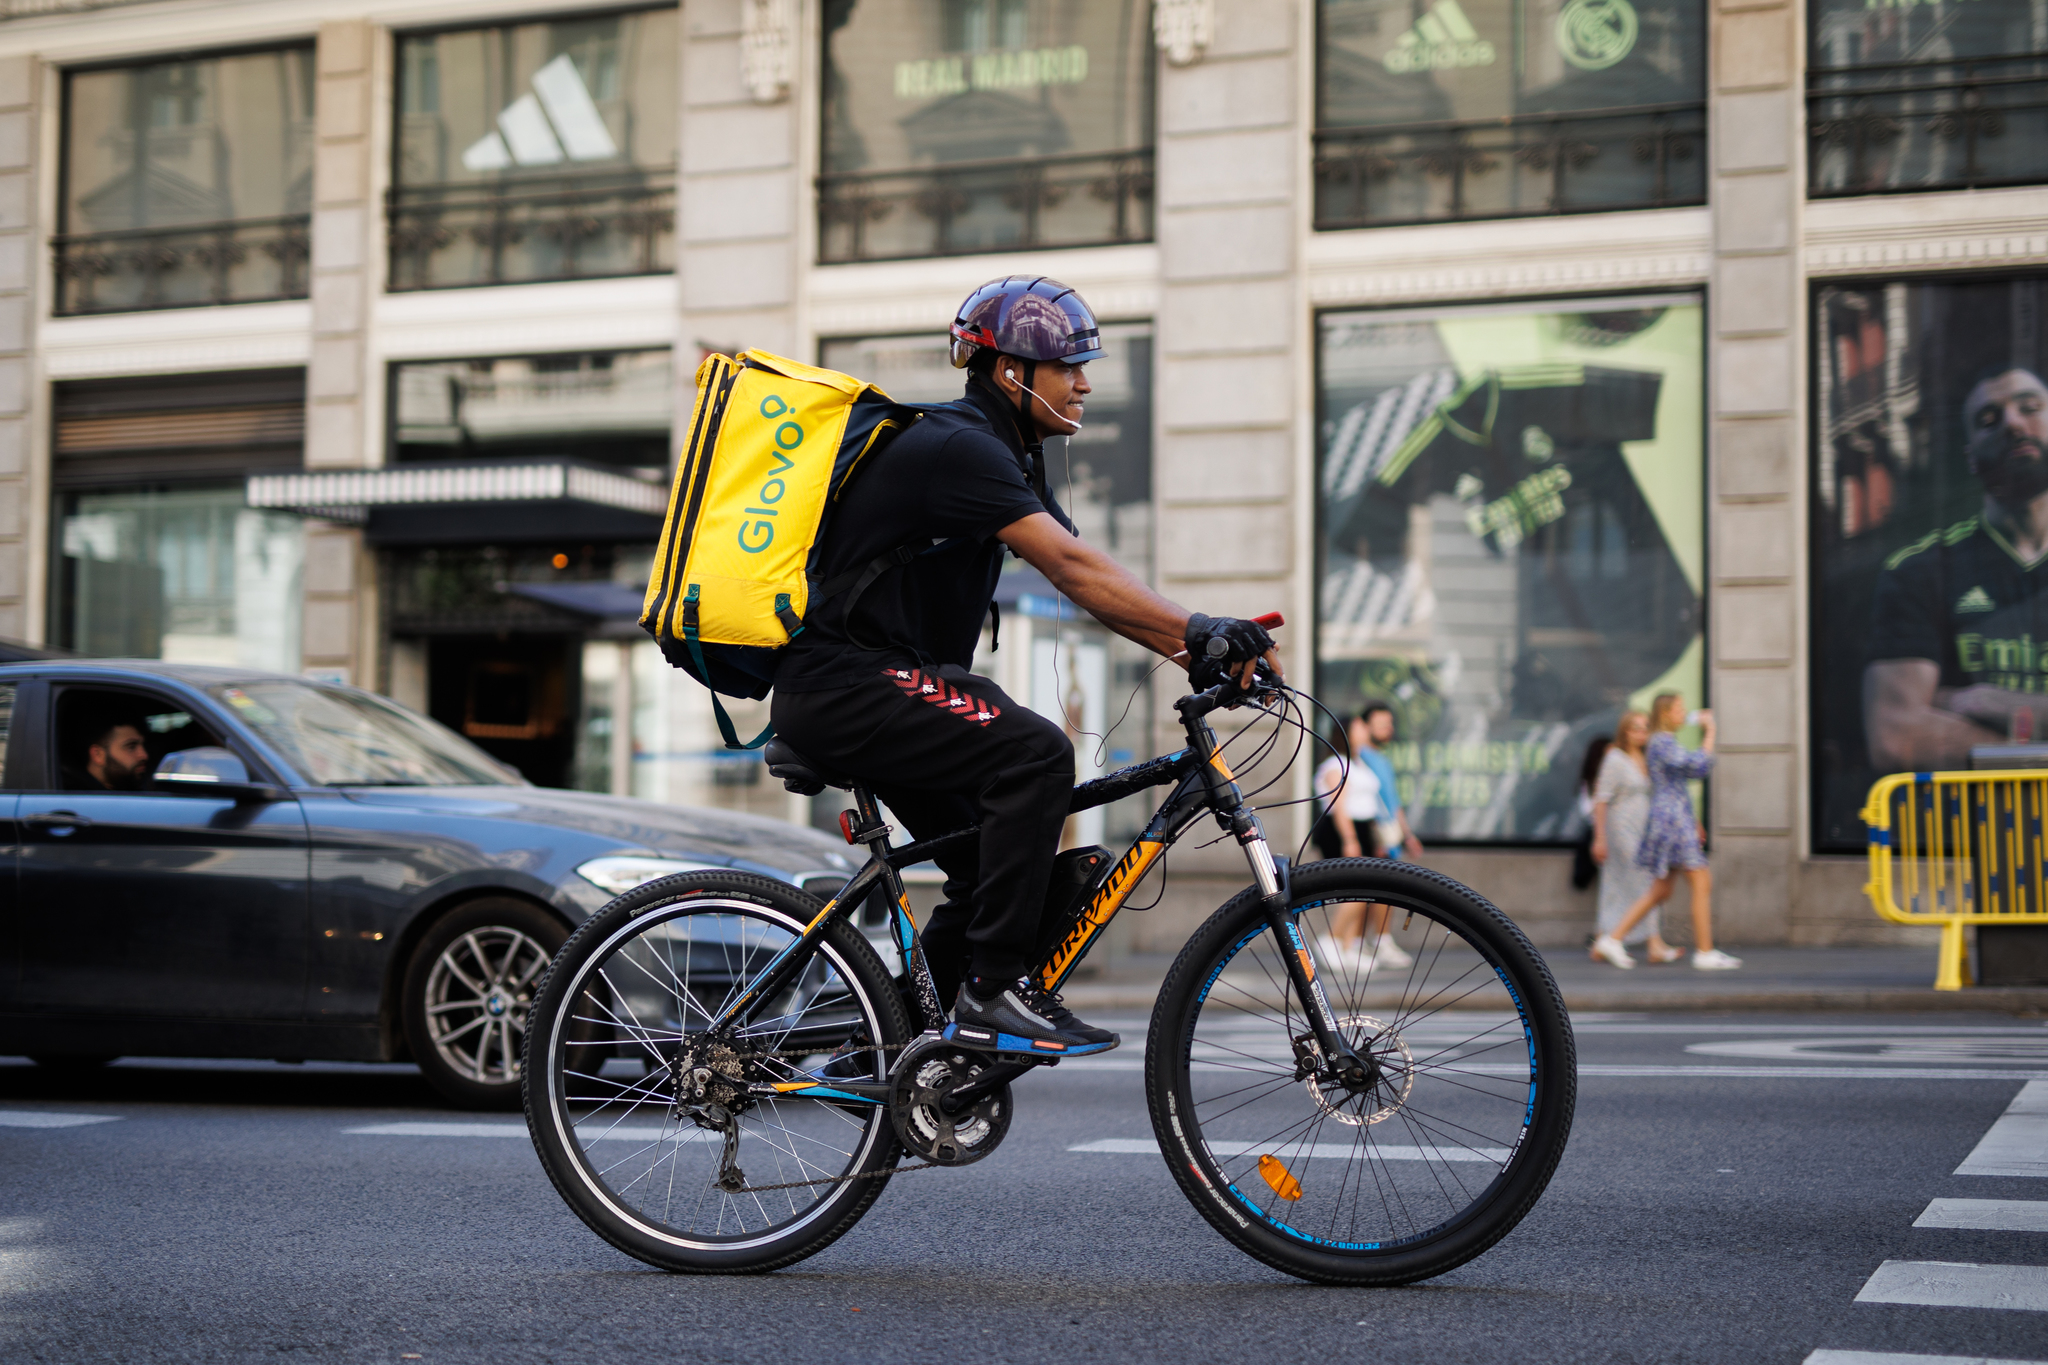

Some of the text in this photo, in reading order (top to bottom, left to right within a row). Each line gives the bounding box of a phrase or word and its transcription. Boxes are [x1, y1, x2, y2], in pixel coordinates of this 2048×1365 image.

[893, 45, 1088, 98] REAL MADRID
[1383, 40, 1496, 75] adidas
[738, 421, 804, 553] Glovo
[629, 895, 676, 918] Panaracer
[1209, 1188, 1249, 1228] Panaracer
